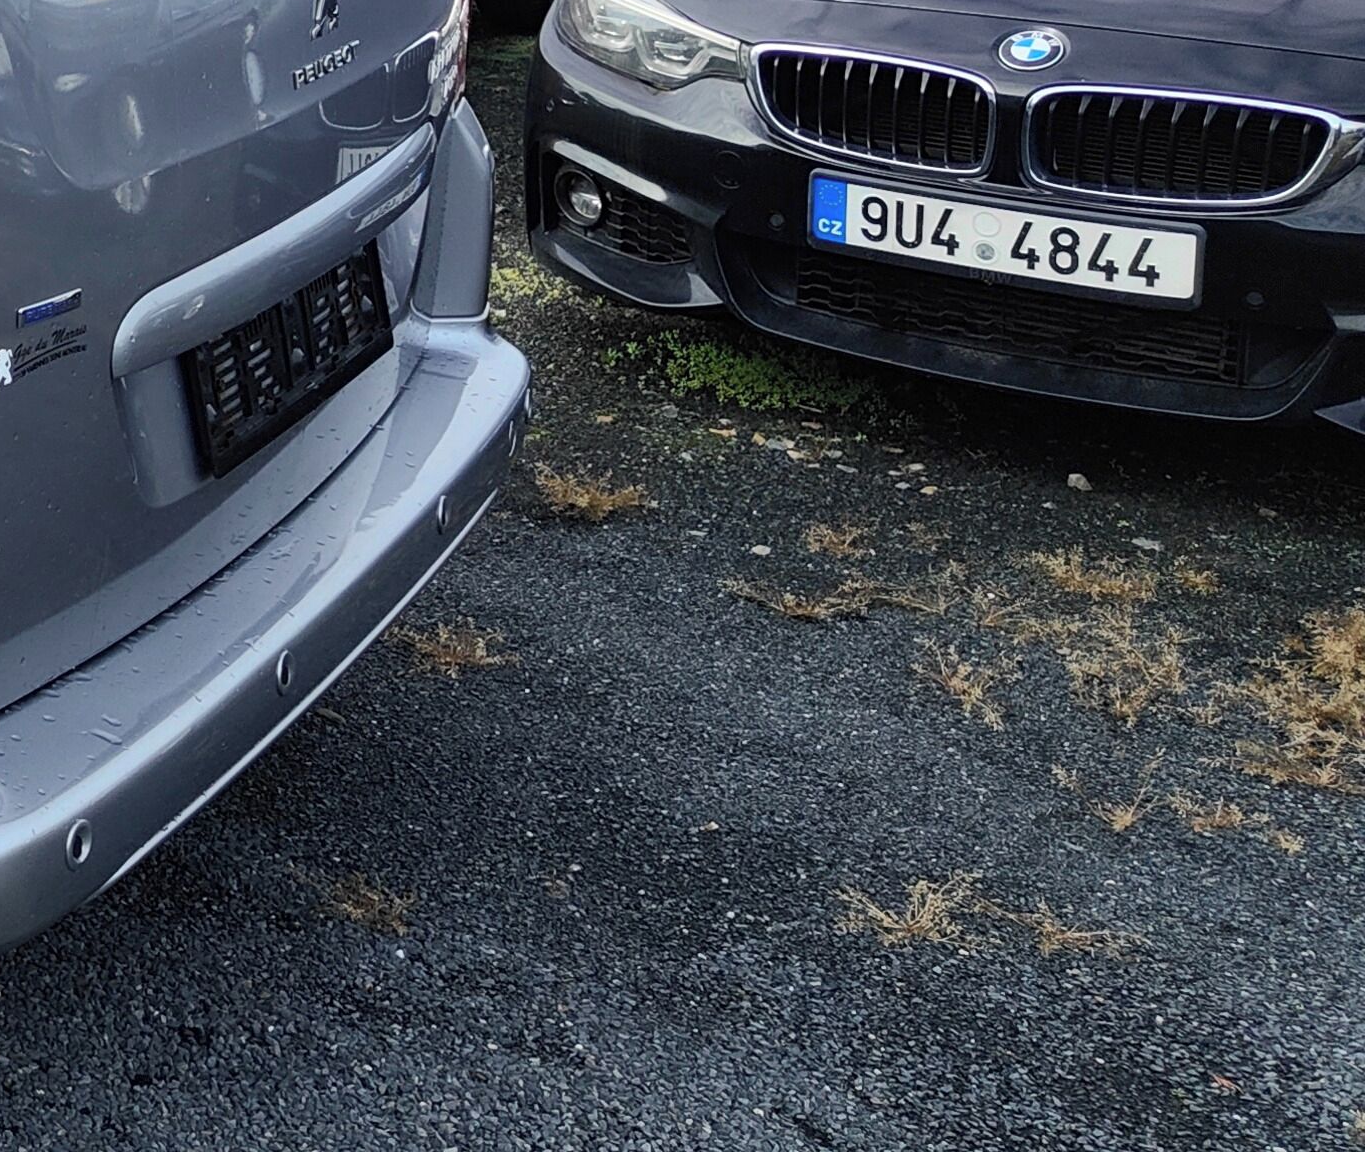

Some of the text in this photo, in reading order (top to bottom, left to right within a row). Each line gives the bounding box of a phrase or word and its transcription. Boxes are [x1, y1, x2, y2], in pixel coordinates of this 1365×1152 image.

[292, 40, 361, 91] PEUGEOT
[818, 218, 844, 236] CZ
[861, 195, 1162, 289] 9U4 4844
[969, 268, 1013, 285] BMW
